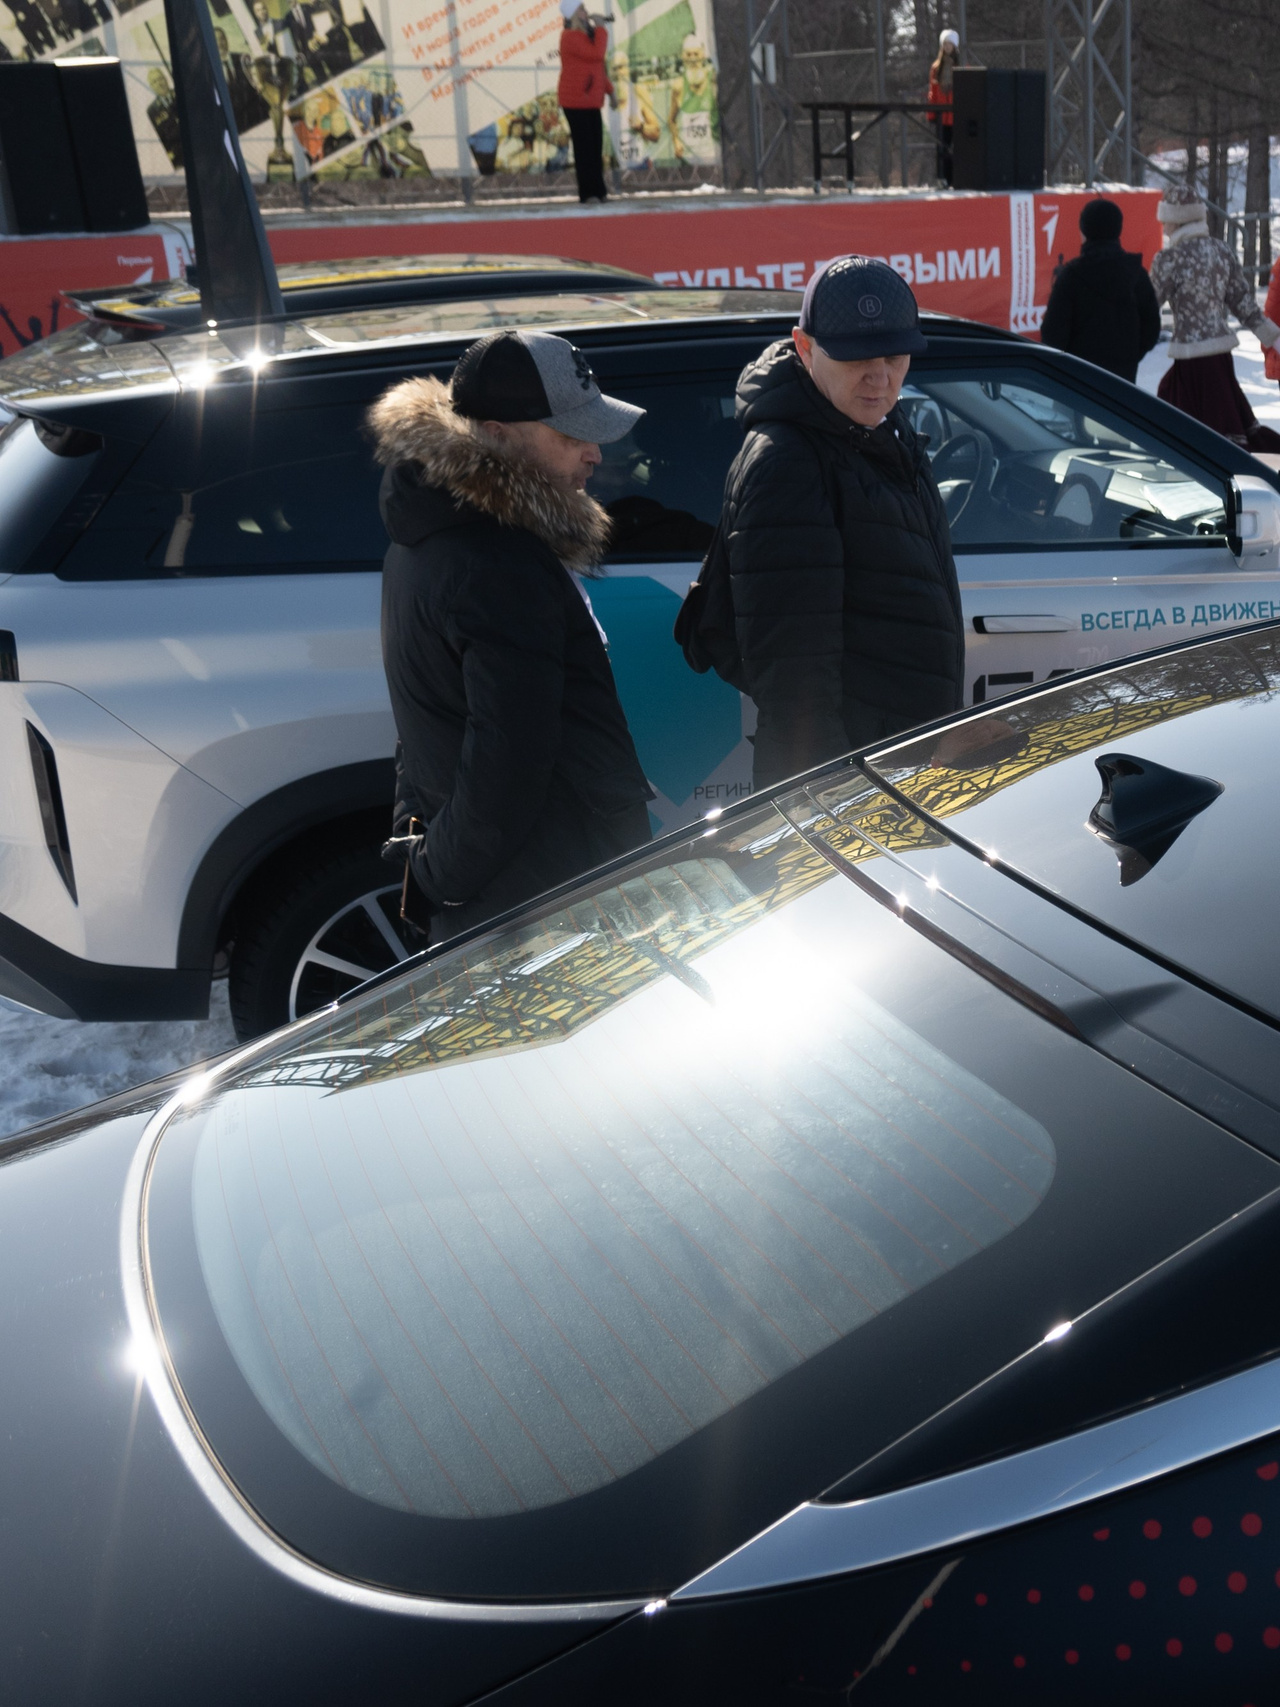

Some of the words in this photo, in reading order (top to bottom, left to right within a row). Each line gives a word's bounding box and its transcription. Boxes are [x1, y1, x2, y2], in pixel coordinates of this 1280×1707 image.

[495, 40, 526, 64] сама
[1081, 608, 1167, 632] ВСЕГДА
[1172, 606, 1186, 625] В
[693, 781, 752, 800] РЕГИН
